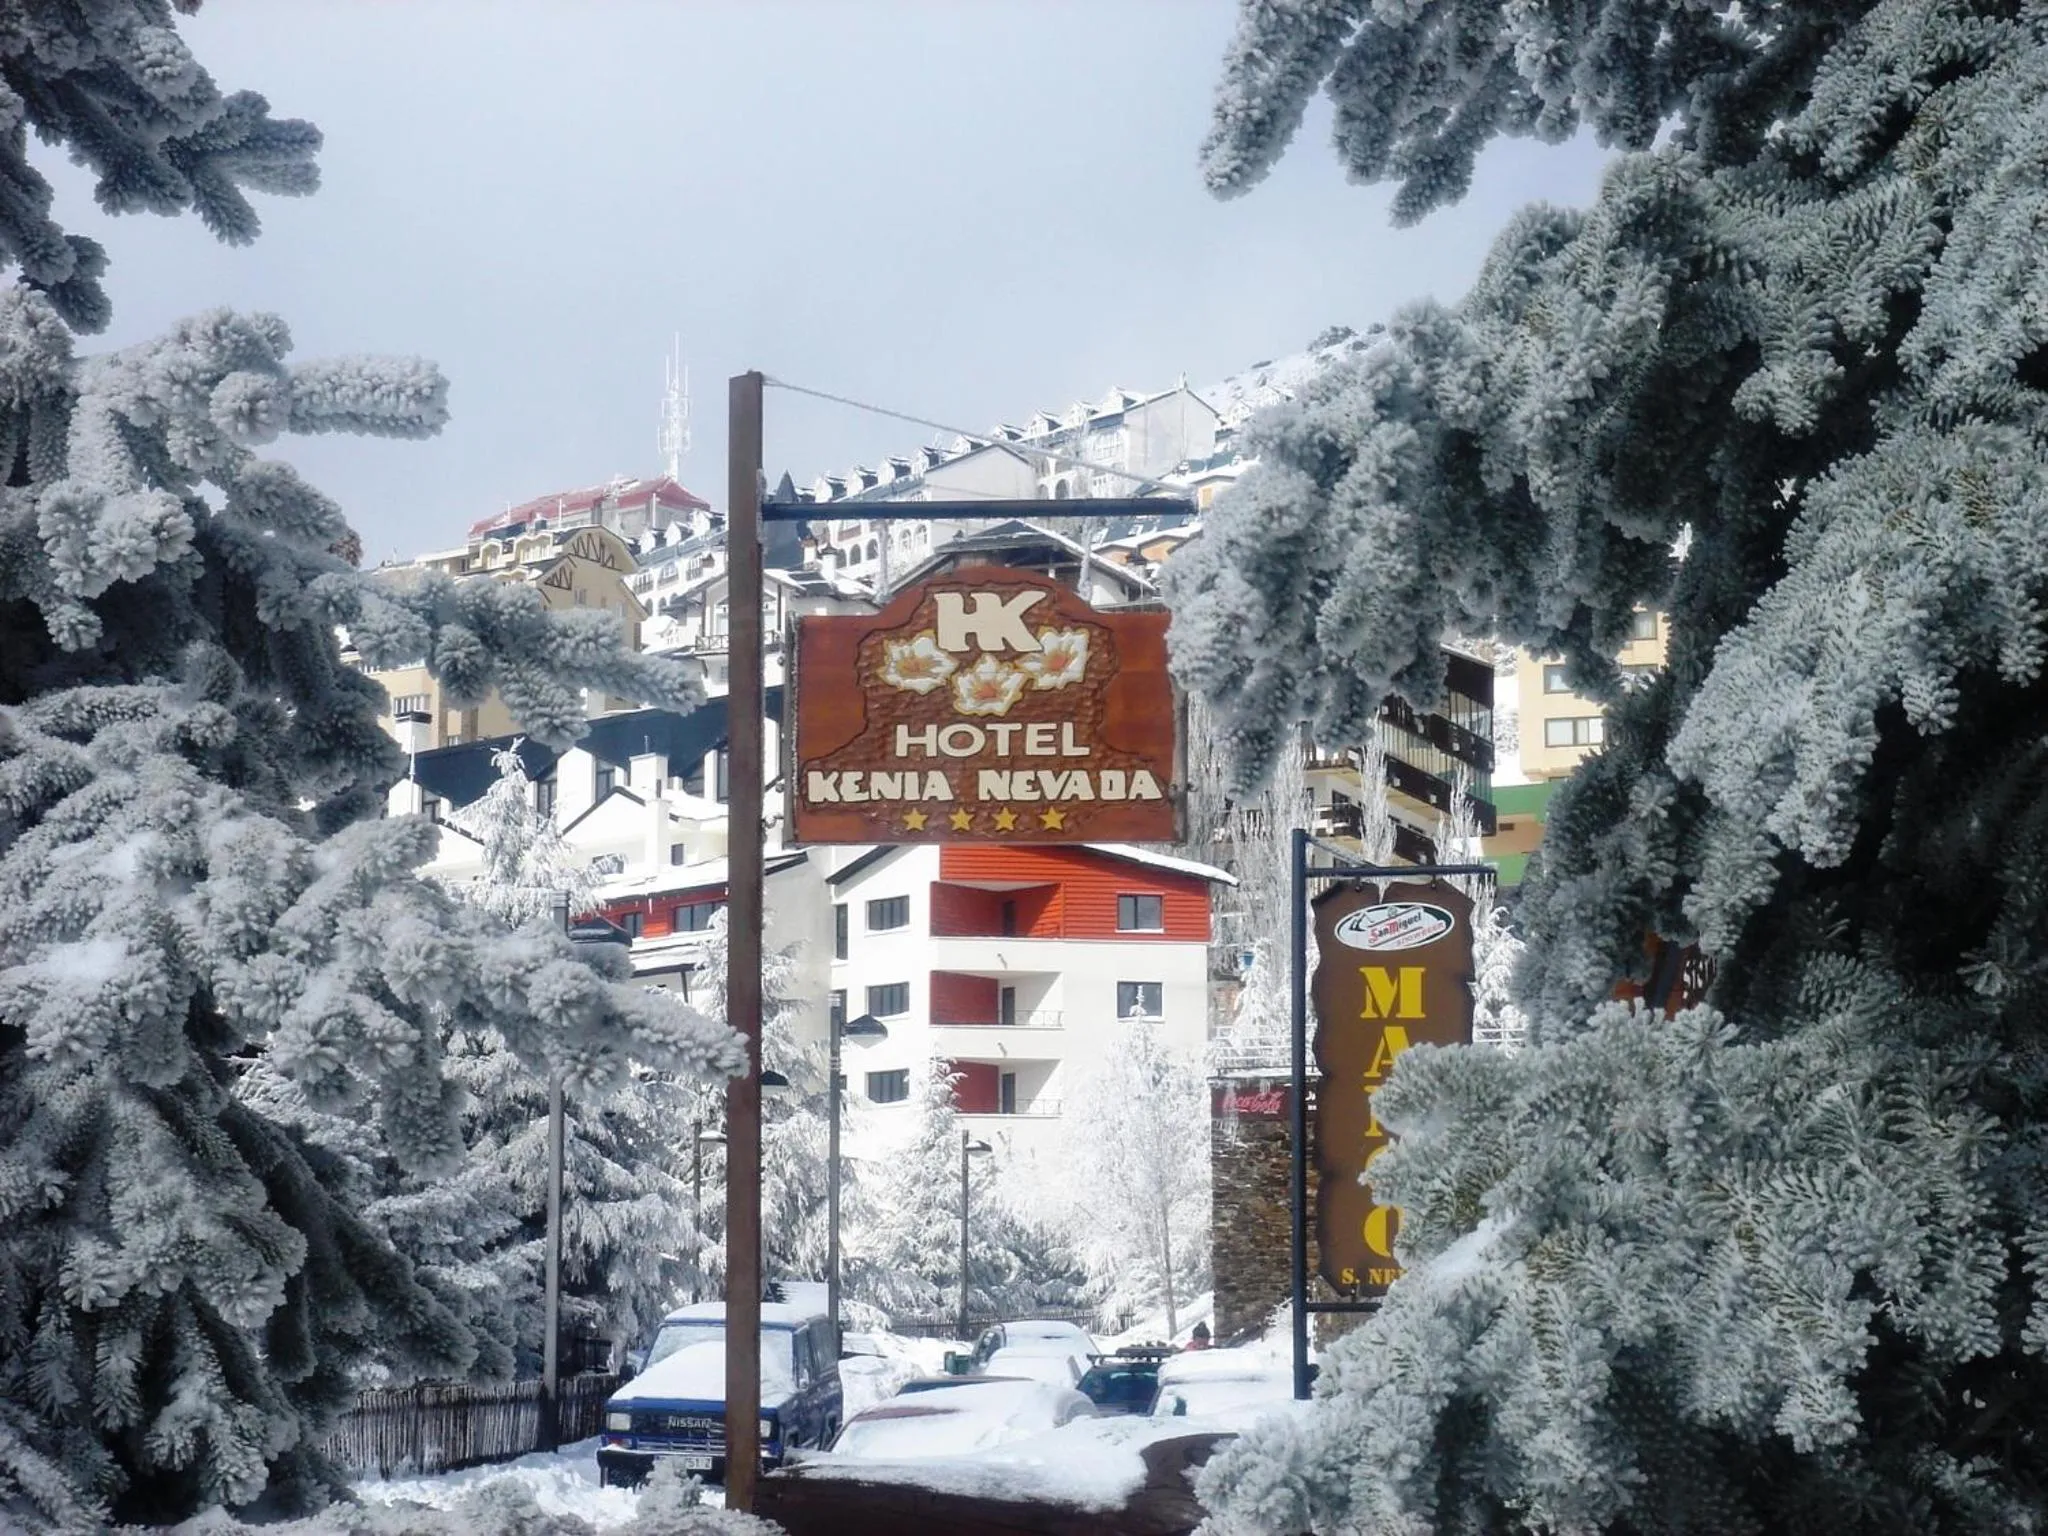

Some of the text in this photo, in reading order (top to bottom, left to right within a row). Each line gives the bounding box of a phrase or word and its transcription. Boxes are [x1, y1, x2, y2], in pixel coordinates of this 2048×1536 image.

[933, 590, 1047, 653] HK
[895, 722, 1091, 758] HOTEL
[806, 769, 1164, 804] KENIA NEVADA
[1340, 1267, 1361, 1285] S.
[667, 1415, 712, 1429] NISSAN
